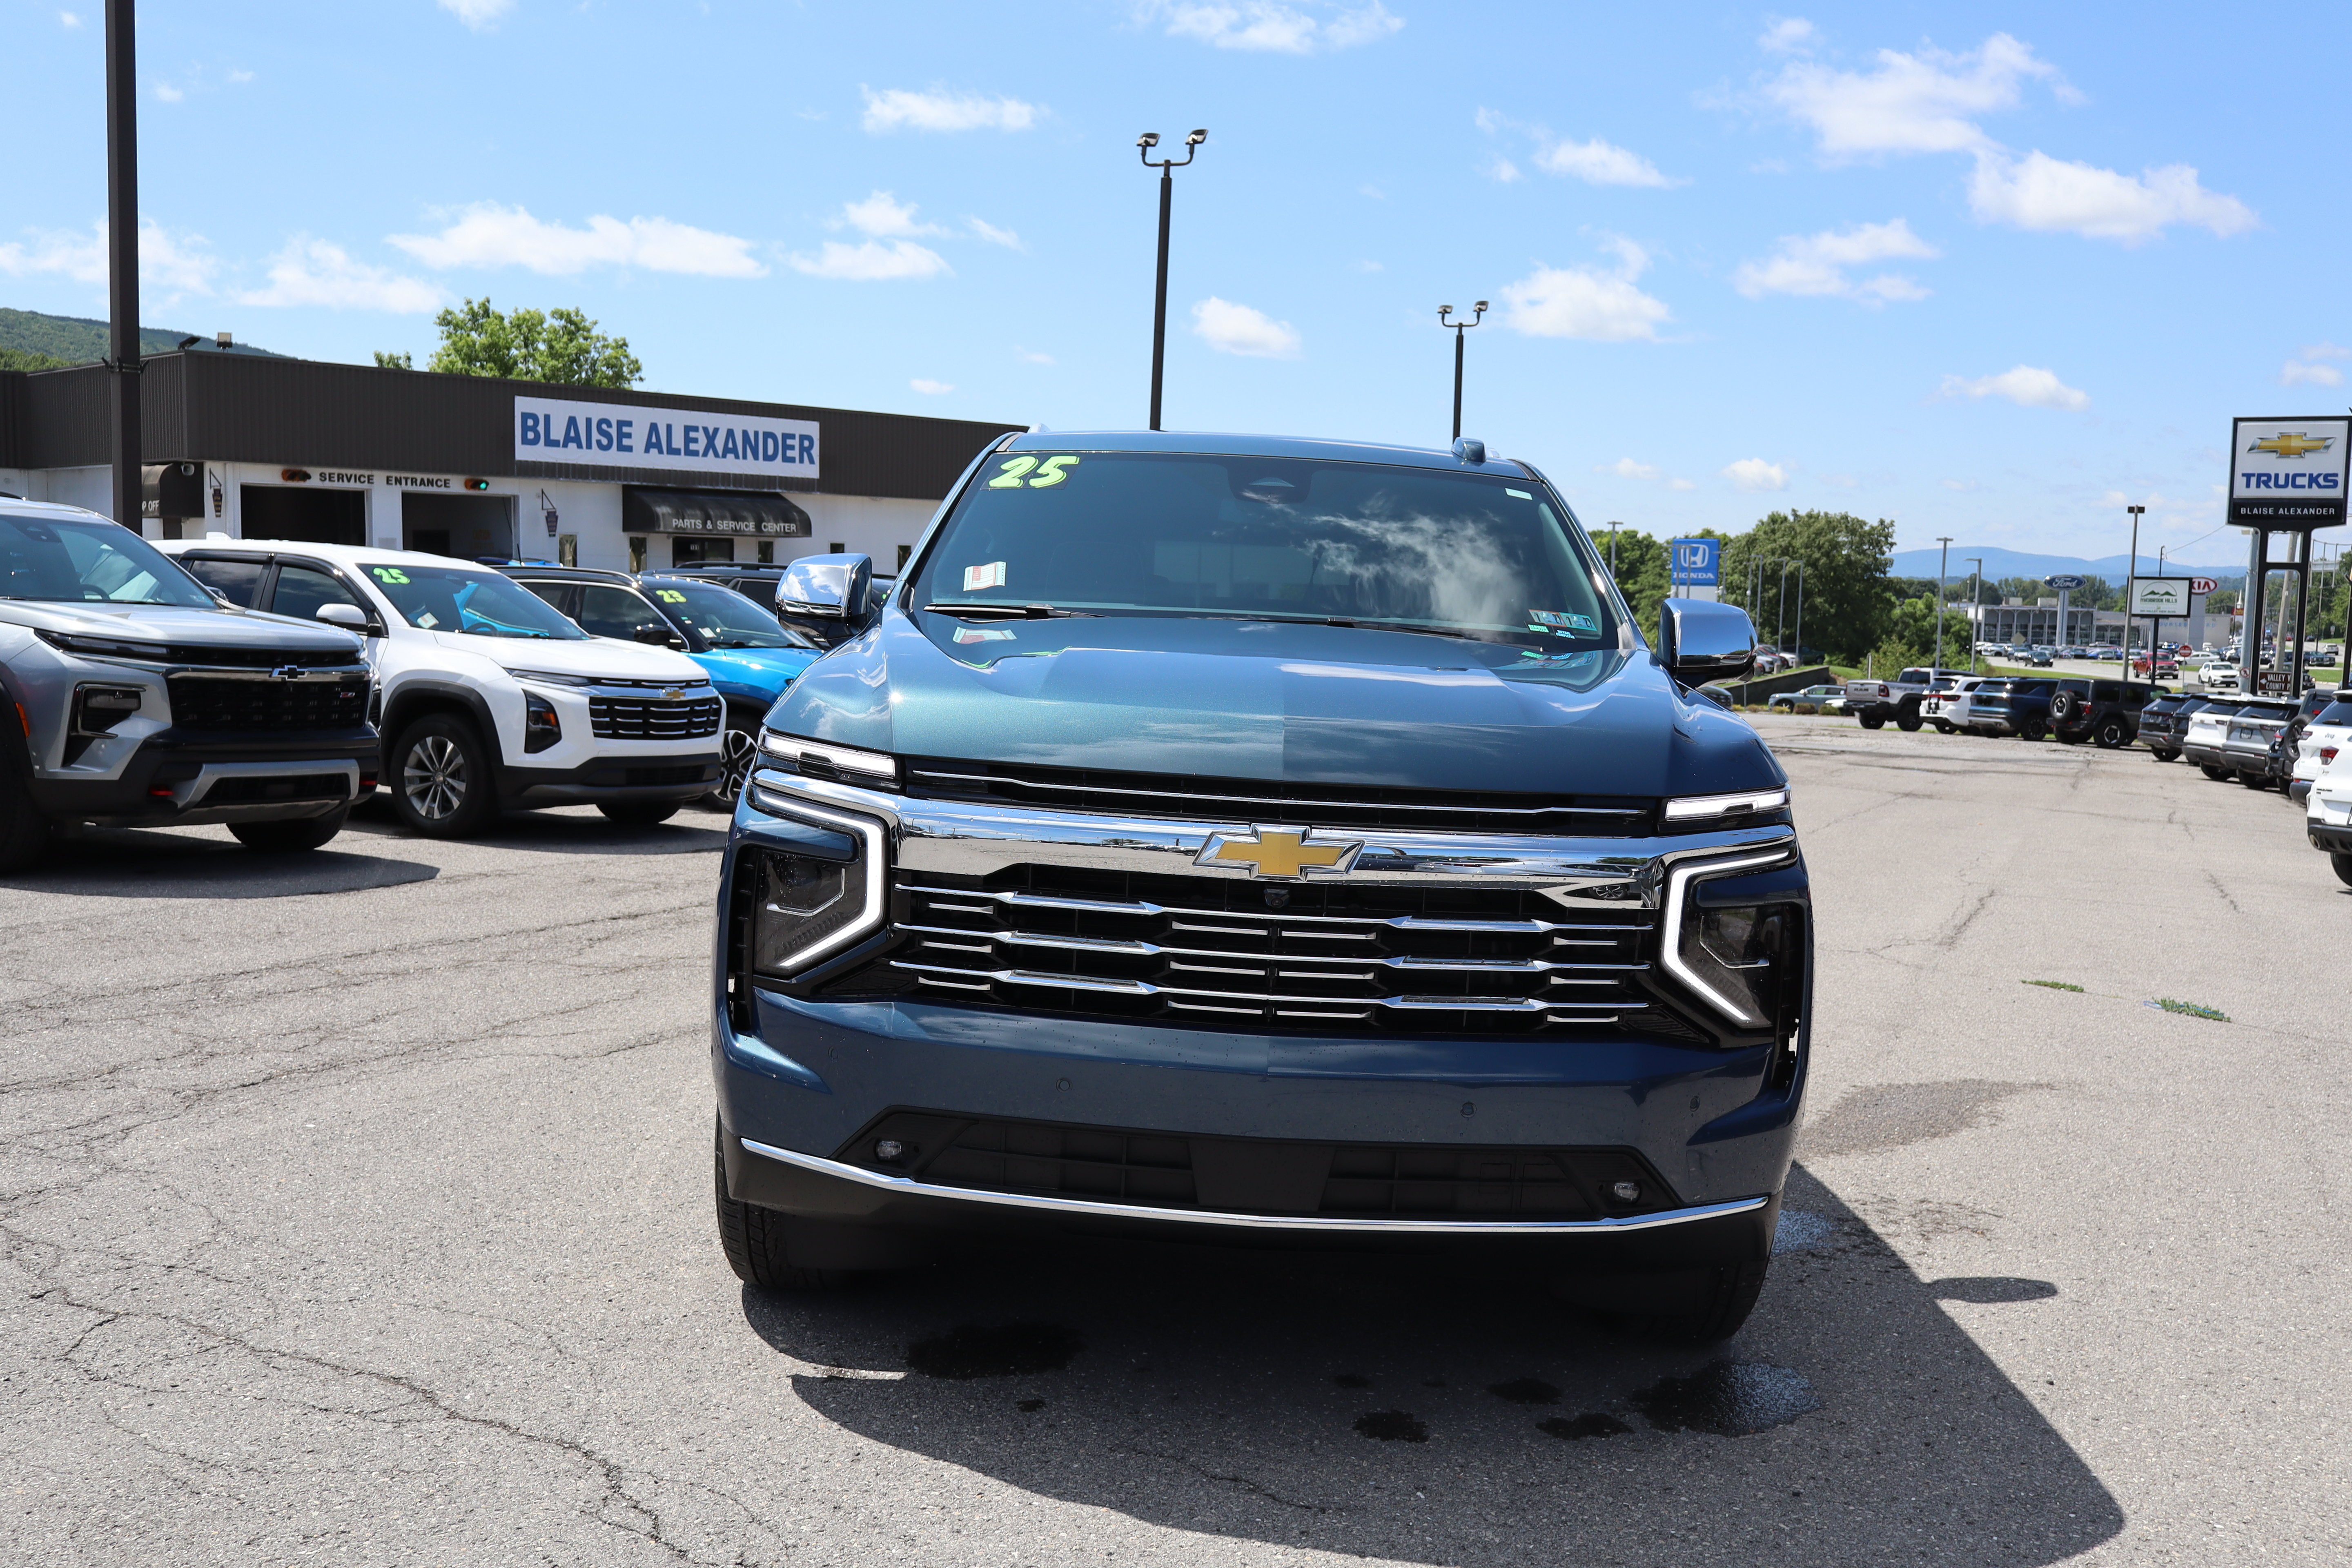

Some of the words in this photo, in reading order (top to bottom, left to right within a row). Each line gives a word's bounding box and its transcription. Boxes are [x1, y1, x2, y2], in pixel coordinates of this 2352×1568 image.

[520, 412, 633, 452] BLAISE
[644, 422, 816, 464] ALEXANDER
[319, 472, 374, 485] SERVICE
[386, 476, 451, 488] ENTRANCE
[989, 456, 1080, 488] 25
[2241, 473, 2339, 489] TRUCKS
[148, 499, 160, 511] OFF
[673, 519, 702, 529] PARTS
[706, 520, 713, 529] &
[717, 520, 755, 531] SERVICE
[761, 523, 797, 532] CENTER
[373, 568, 410, 584] 25
[2052, 577, 2078, 587] Ford
[655, 590, 687, 603] 23
